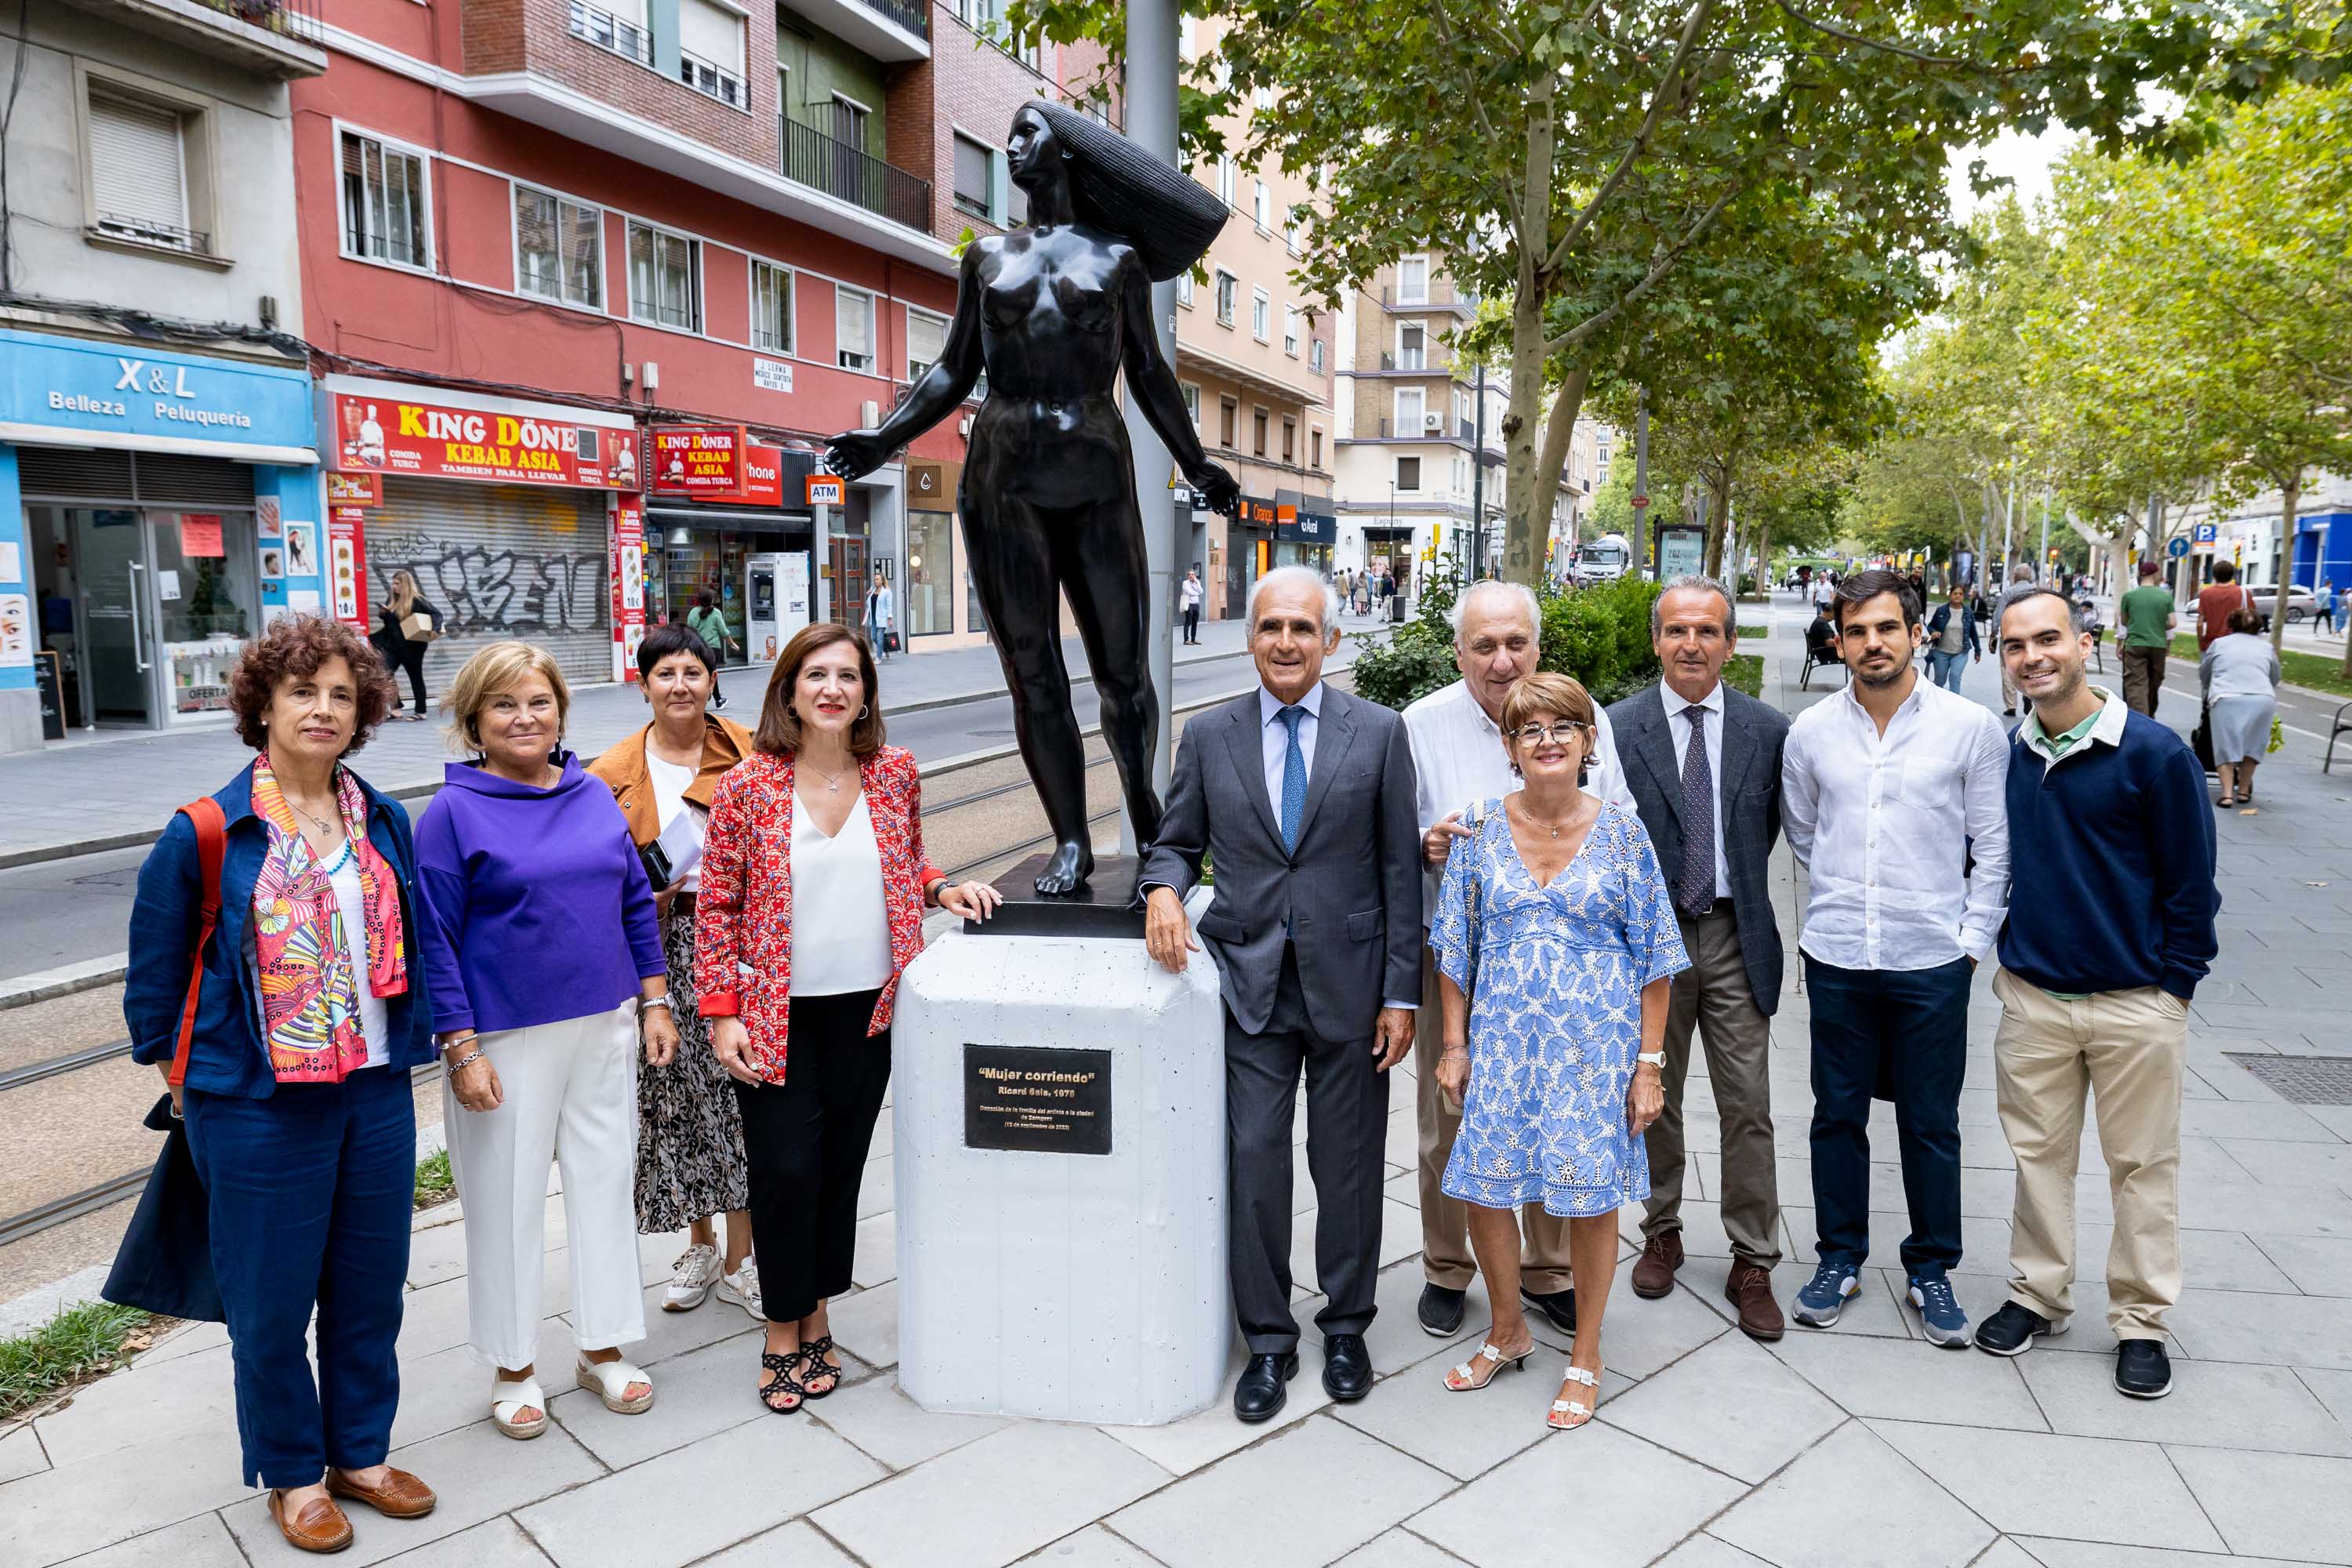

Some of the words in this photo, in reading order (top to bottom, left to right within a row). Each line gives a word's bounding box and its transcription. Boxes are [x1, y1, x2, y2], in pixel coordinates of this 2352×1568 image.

[114, 358, 144, 391] X
[148, 368, 169, 394] &
[176, 366, 195, 398] L
[48, 391, 125, 416] Belleza
[398, 405, 487, 443] KING
[496, 416, 578, 452] DÖNE
[658, 435, 690, 449] KING
[692, 434, 732, 449] DÖNER
[389, 449, 422, 460] COMIDA
[445, 443, 512, 466] KEBAB
[517, 449, 561, 471] ASIA
[688, 451, 731, 463] KEBAB
[392, 459, 420, 470] TURCA
[694, 464, 724, 476] ASIA
[440, 464, 492, 476] TAMBIEN
[495, 468, 525, 478] PARA
[528, 470, 567, 481] LLEVAR
[712, 477, 734, 485] TURCA
[812, 486, 837, 497] ATM
[1254, 503, 1274, 526] Orange
[1307, 517, 1318, 534] Aural
[2198, 526, 2212, 541] P
[998, 1087, 1026, 1095] Ricard
